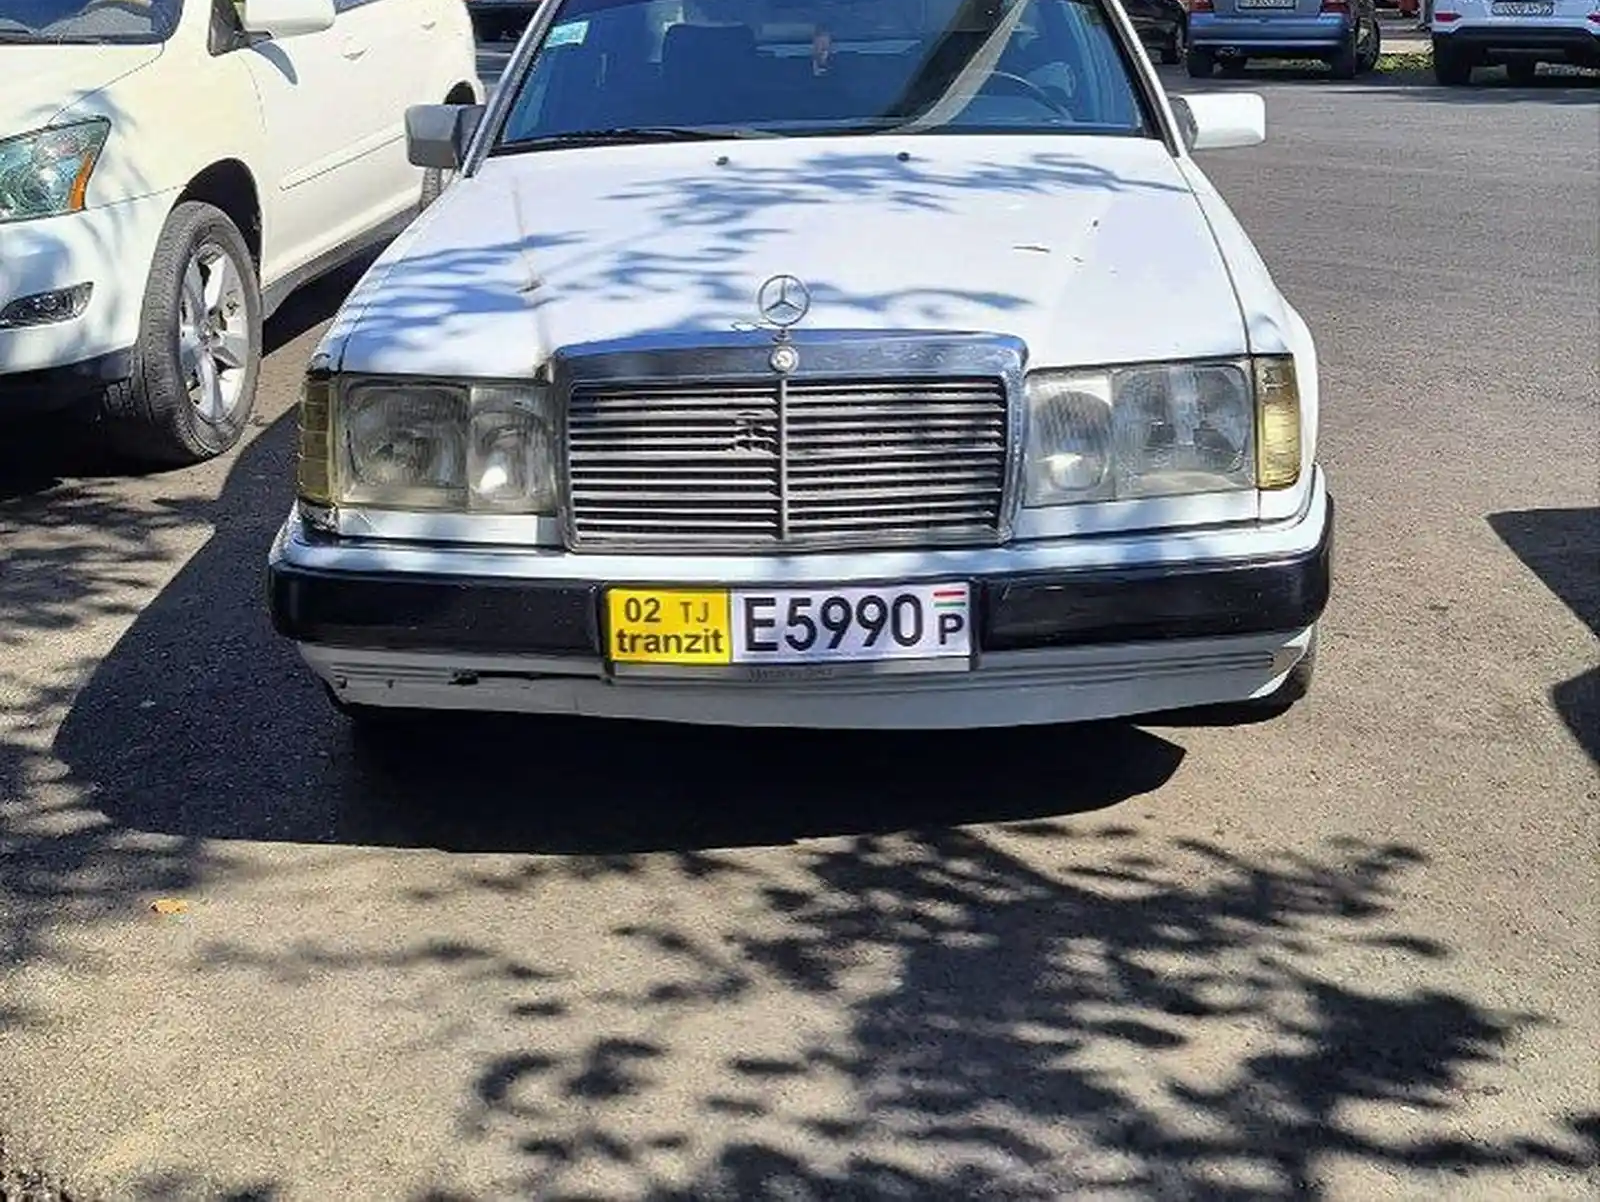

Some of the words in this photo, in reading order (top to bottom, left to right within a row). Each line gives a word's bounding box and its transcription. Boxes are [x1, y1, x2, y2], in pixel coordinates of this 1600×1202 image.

[624, 597, 661, 624] 02
[681, 601, 709, 624] TJ
[745, 594, 922, 652] E5990
[939, 613, 964, 646] P
[616, 628, 724, 654] tranzit
